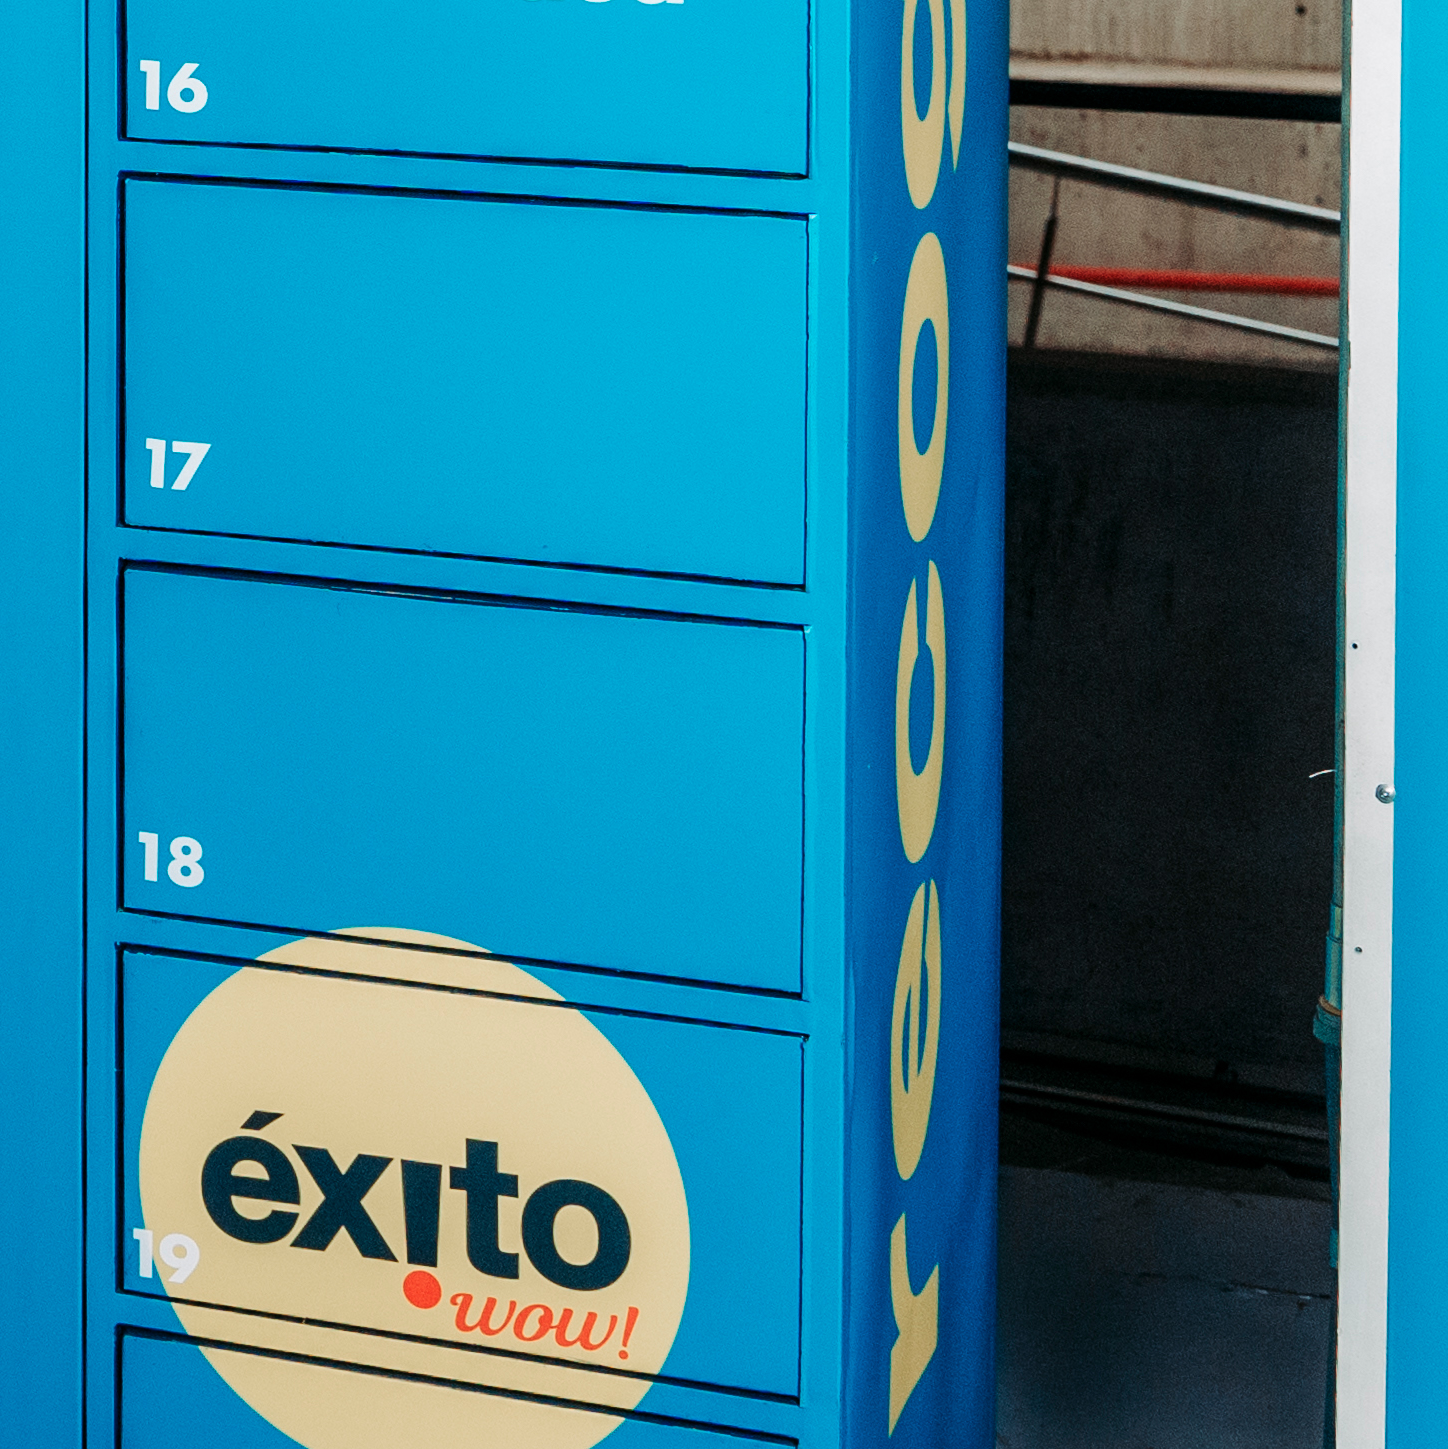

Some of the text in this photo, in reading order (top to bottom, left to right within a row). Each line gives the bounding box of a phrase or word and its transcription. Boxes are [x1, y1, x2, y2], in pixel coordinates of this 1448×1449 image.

[139, 59, 209, 114] 16
[144, 437, 211, 492] 17
[137, 830, 206, 889] 18
[200, 1110, 632, 1309] éxito
[132, 1227, 201, 1285] 19
[449, 1283, 640, 1361] wow!
